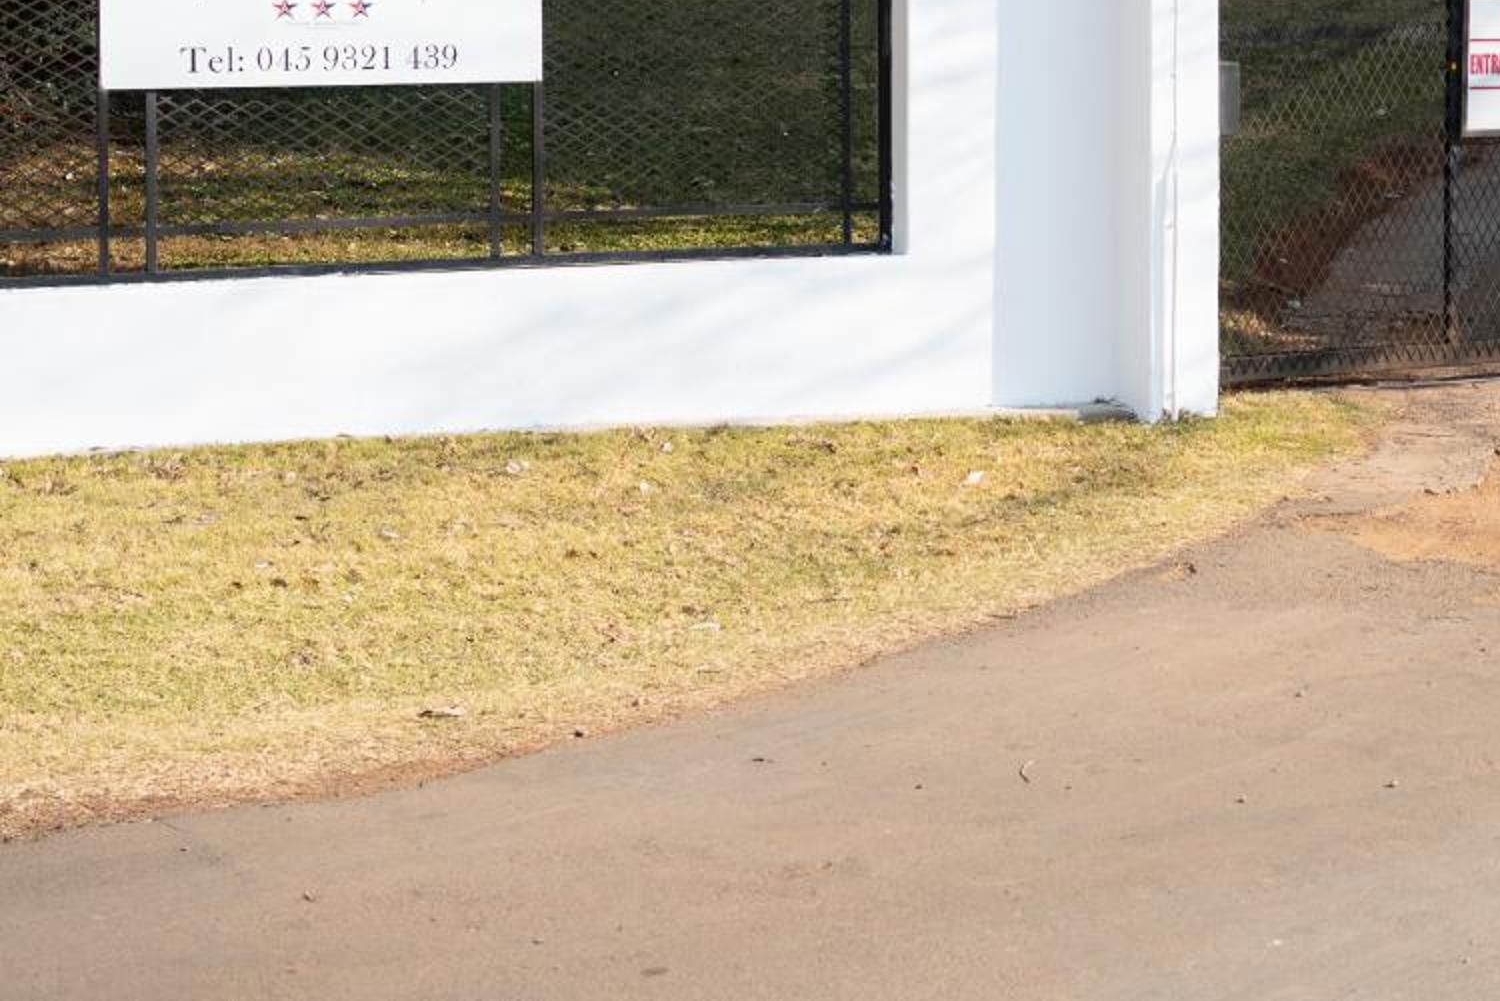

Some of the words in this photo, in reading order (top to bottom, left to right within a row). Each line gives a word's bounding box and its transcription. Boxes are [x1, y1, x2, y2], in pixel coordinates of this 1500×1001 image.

[180, 46, 244, 73] Tel:
[256, 45, 312, 72] 045
[322, 44, 391, 71] 9321
[408, 43, 459, 70] 439
